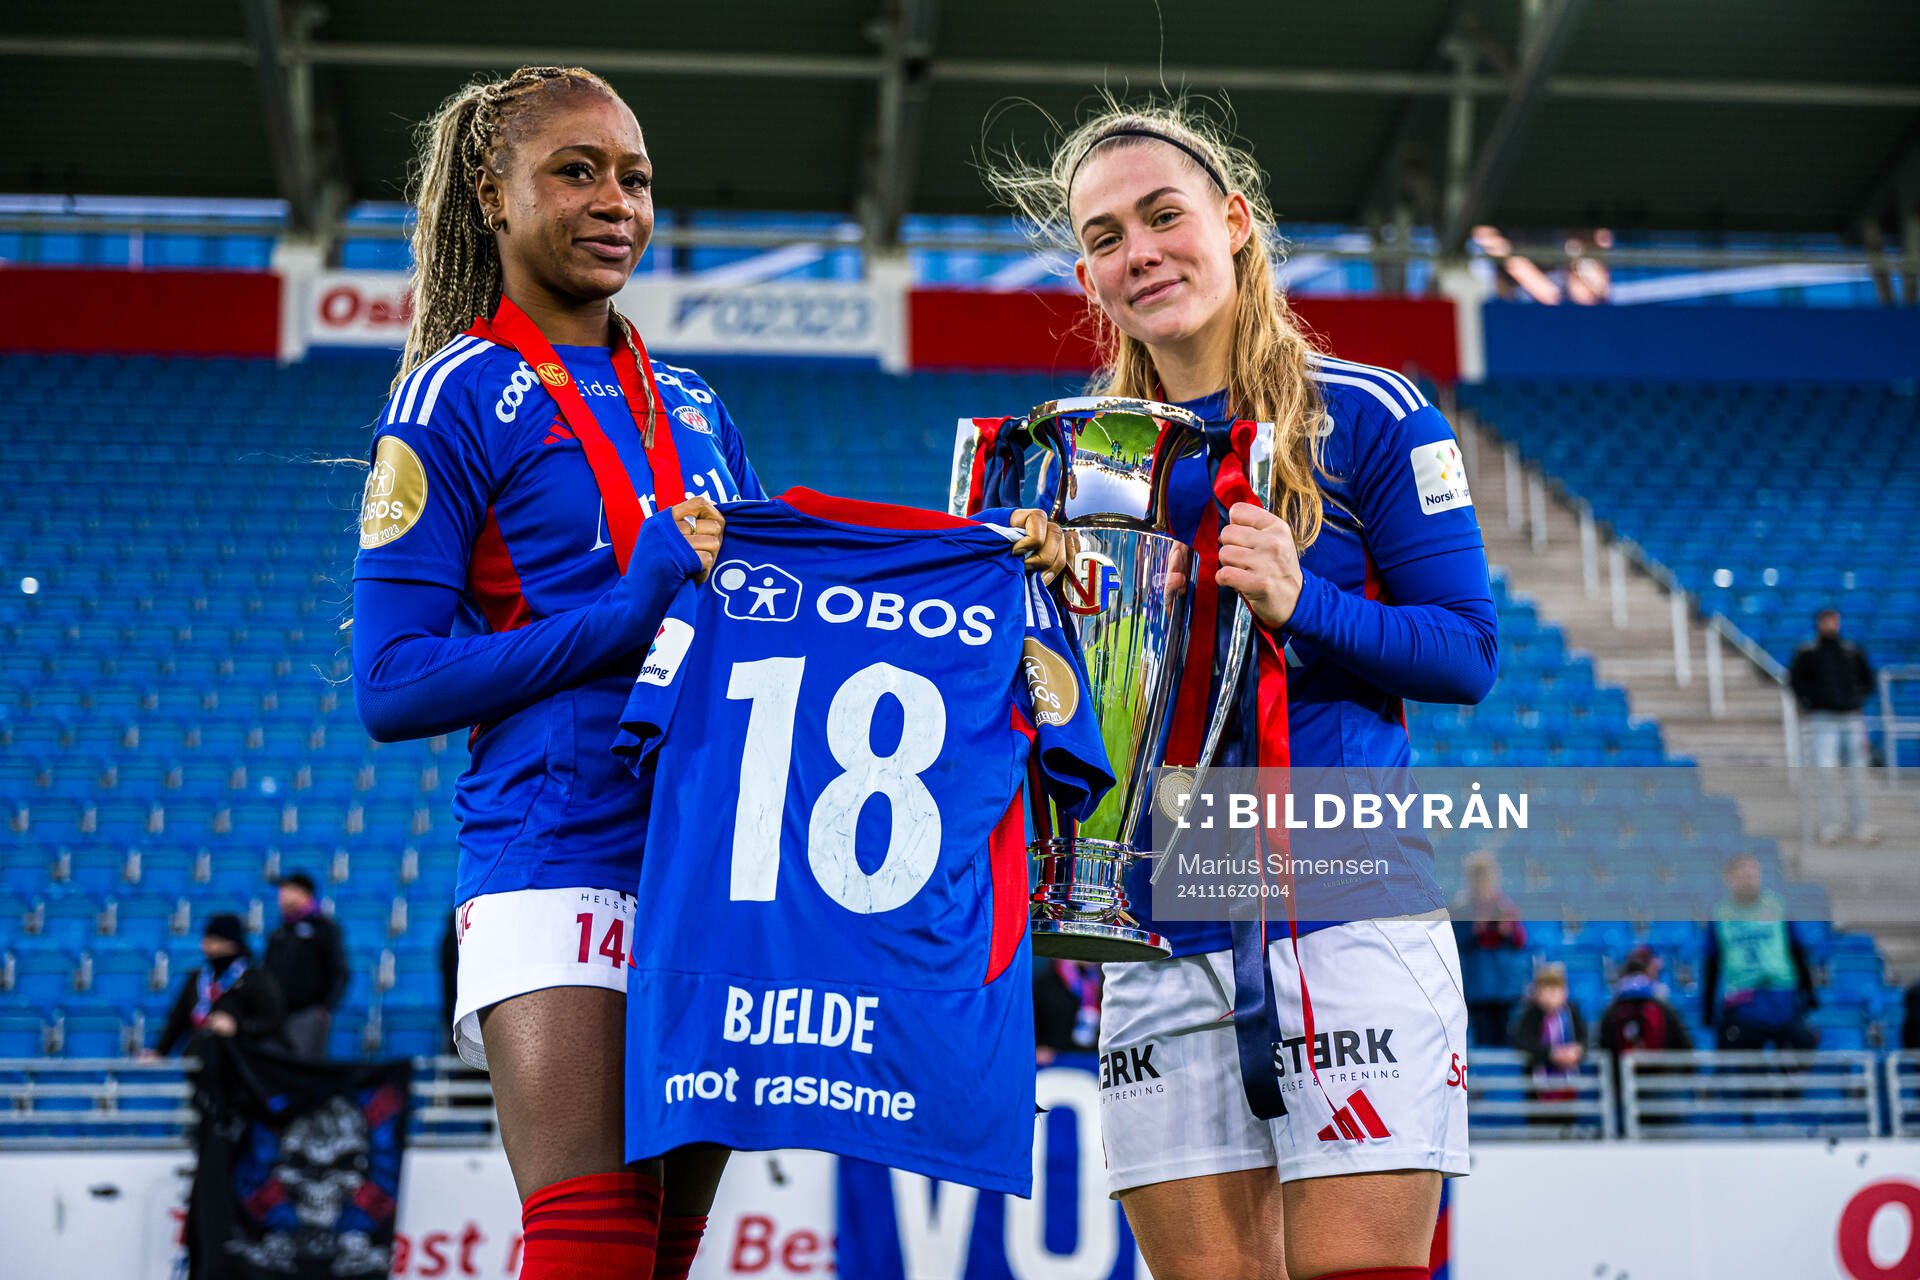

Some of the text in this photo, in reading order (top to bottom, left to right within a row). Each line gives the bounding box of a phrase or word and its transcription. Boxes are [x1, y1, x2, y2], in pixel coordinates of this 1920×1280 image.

[816, 586, 996, 646] OBOS
[726, 656, 947, 915] 18
[581, 893, 628, 913] HELSE
[576, 912, 625, 970] 14
[723, 986, 879, 1055] BJELDE
[666, 1067, 917, 1121] mot rasisme
[1109, 1084, 1164, 1102] TRENING
[1282, 1080, 1303, 1093] ELSE
[1330, 1069, 1400, 1083] TRENING
